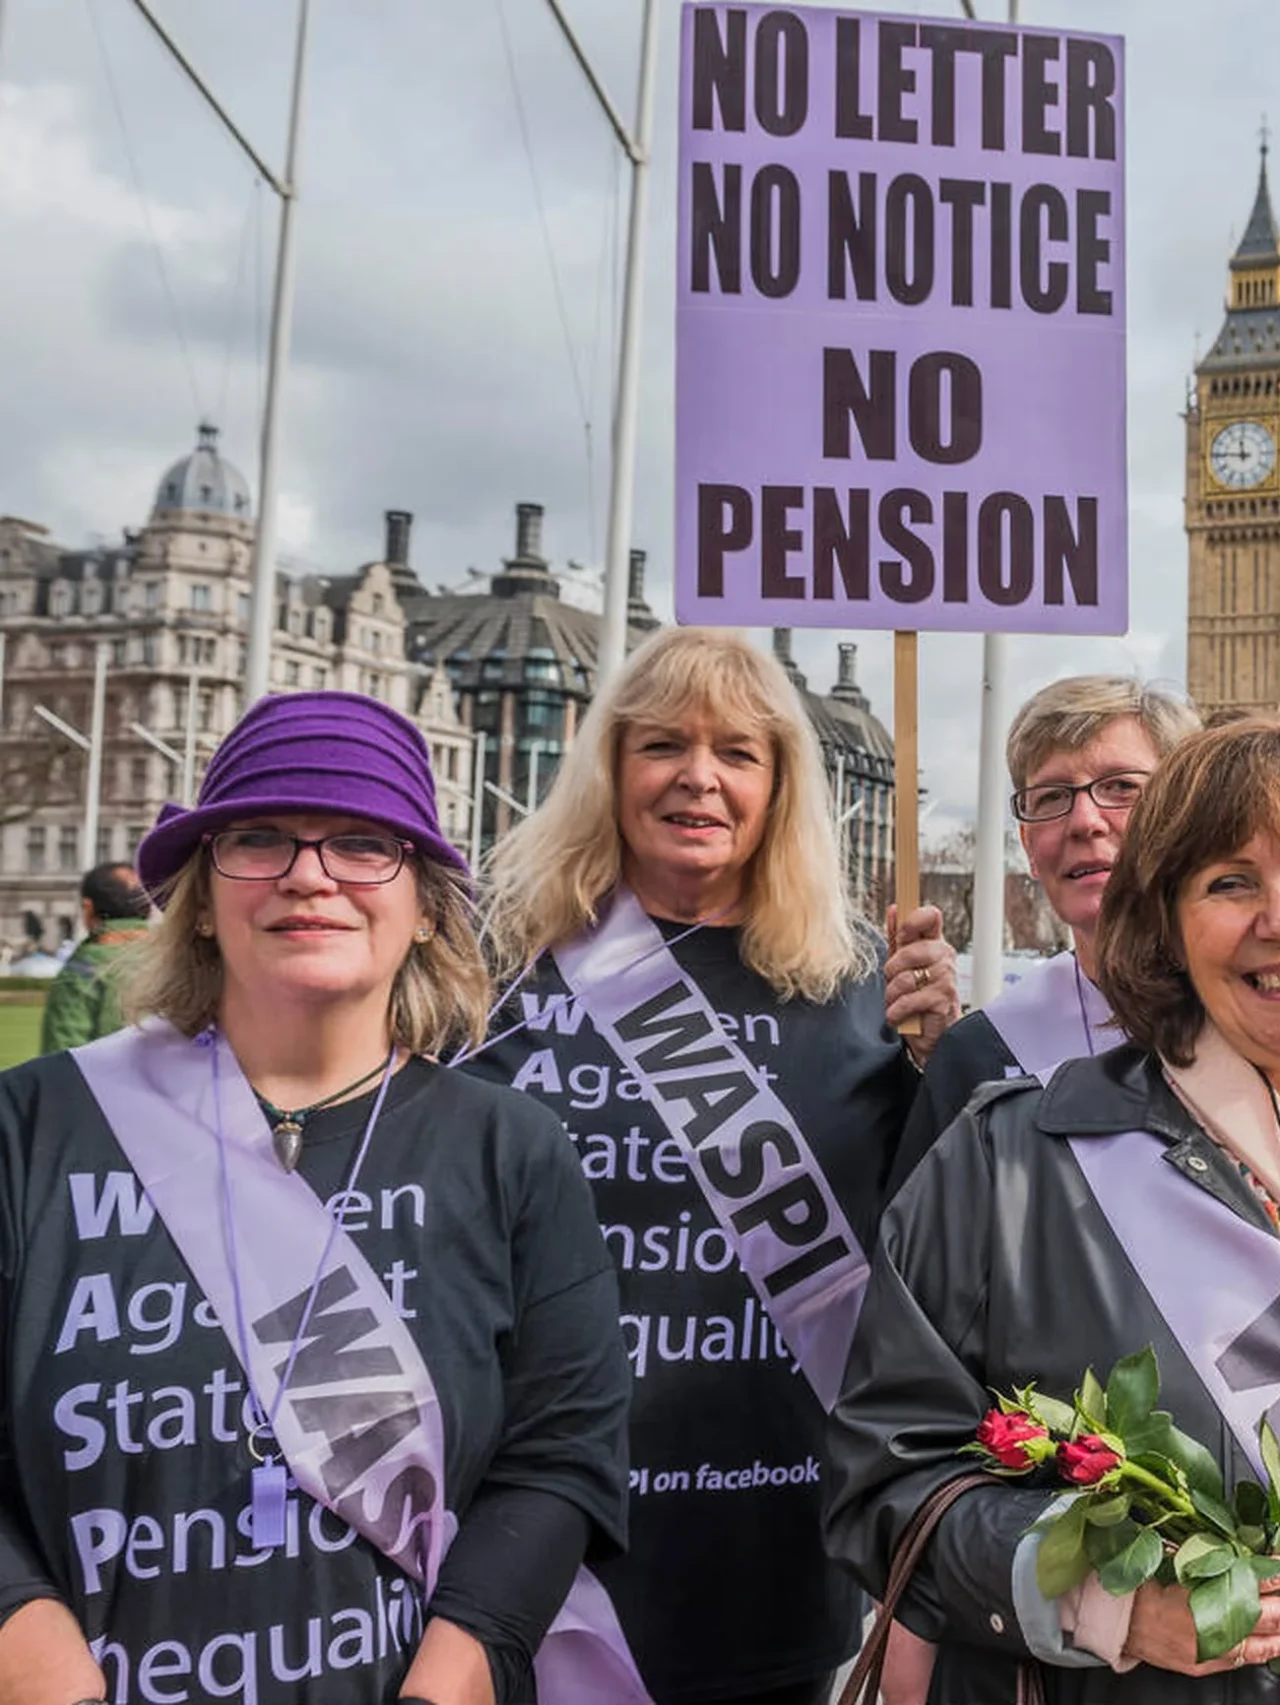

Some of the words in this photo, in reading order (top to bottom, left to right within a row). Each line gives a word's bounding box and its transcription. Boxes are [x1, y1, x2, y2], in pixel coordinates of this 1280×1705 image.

[692, 9, 809, 137] NO
[835, 16, 1116, 161] LETTER
[691, 162, 800, 298] NO
[828, 169, 1112, 316] NOTICE
[823, 347, 982, 464] NO
[698, 483, 1098, 607] PENSION
[612, 979, 850, 1298] WASPI
[69, 1171, 425, 1240] Wen
[653, 1470, 690, 1493] on
[696, 1456, 820, 1490] facebook
